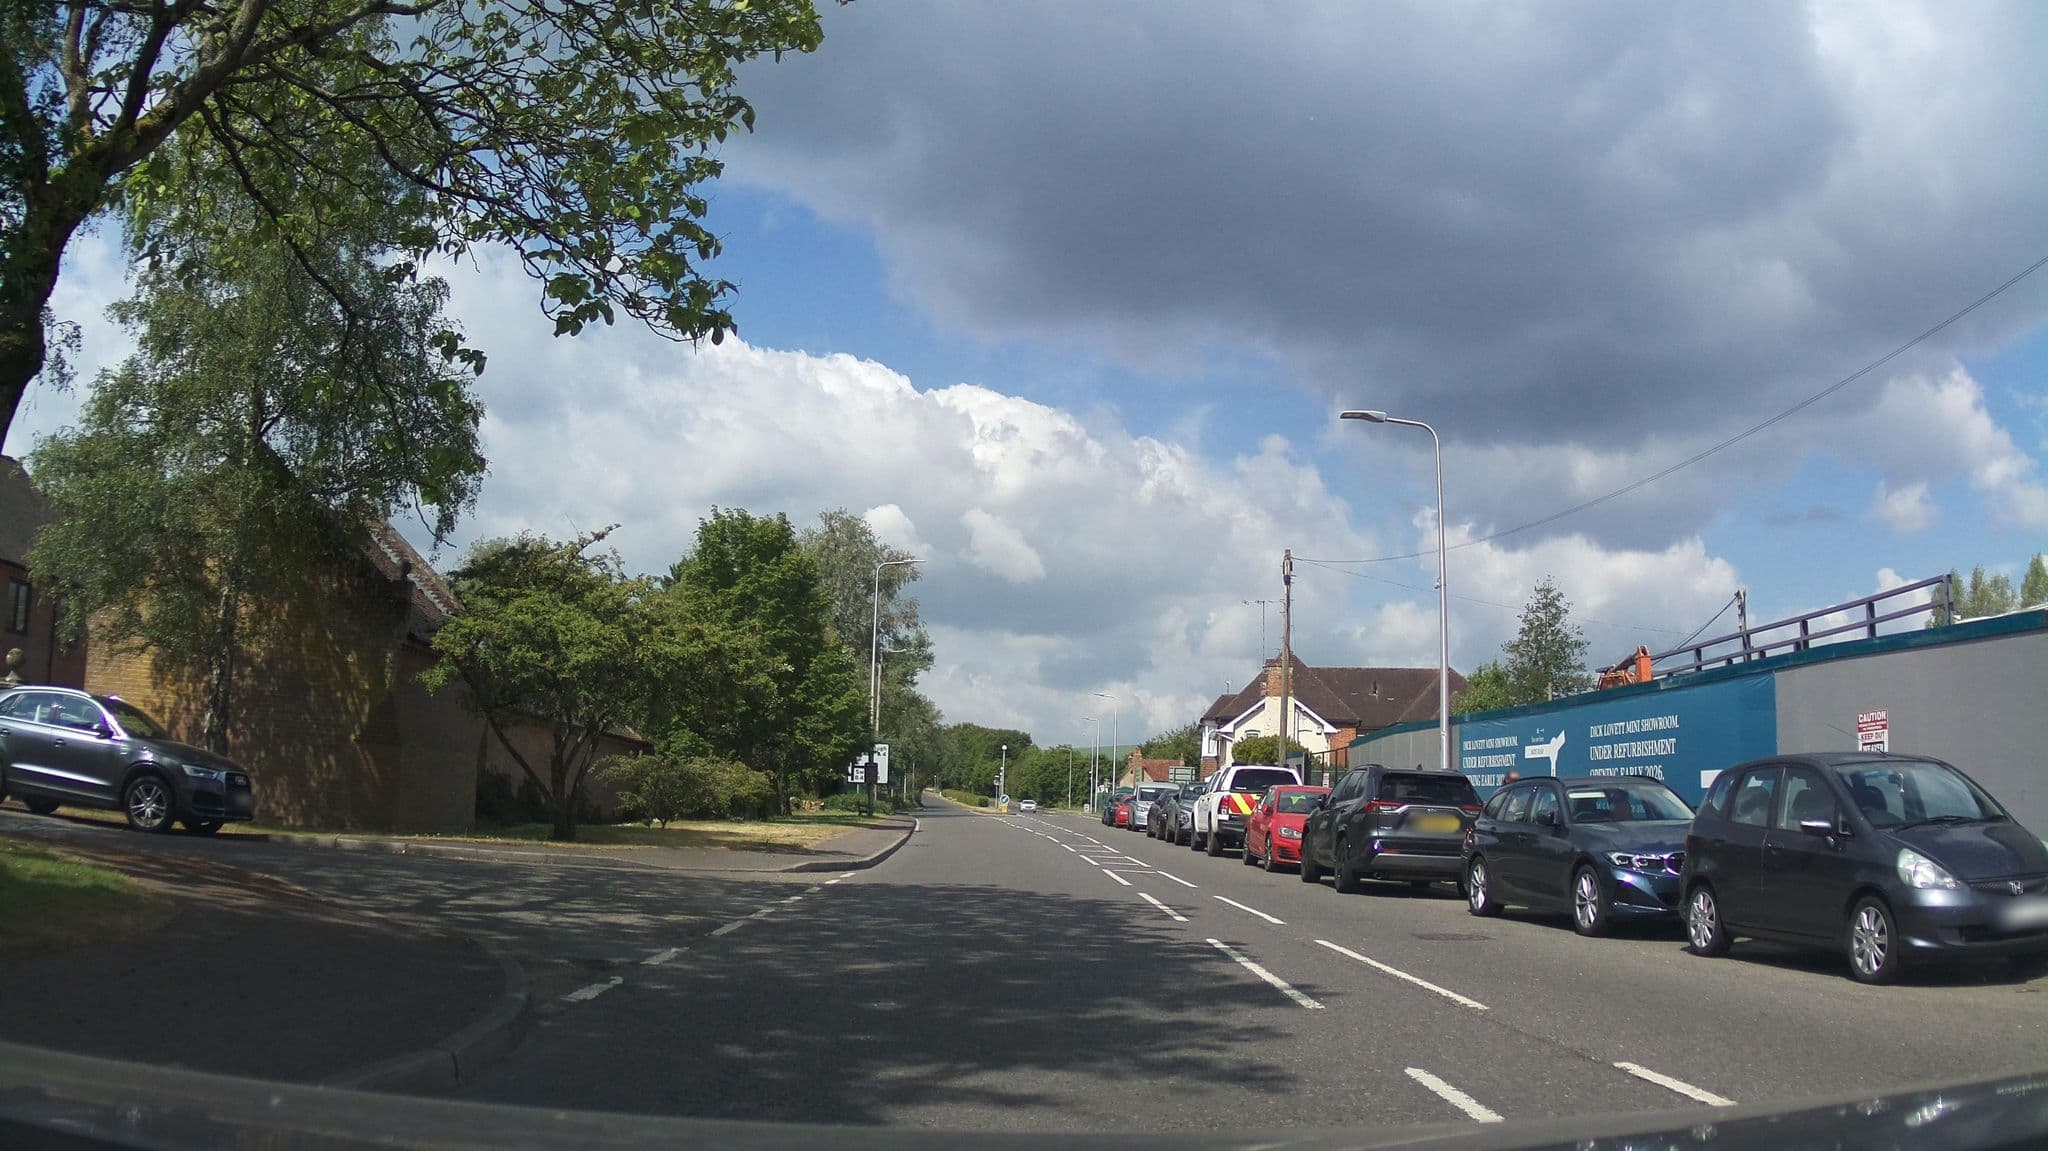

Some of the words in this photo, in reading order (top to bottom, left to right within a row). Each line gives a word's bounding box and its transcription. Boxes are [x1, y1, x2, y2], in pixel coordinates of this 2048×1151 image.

[1859, 711, 1886, 723] CAUTION
[1590, 724, 1603, 738] DICK
[1604, 722, 1625, 736] LOVETT
[1626, 720, 1640, 734] MINI
[1861, 732, 1873, 740] KEEP
[1875, 731, 1885, 739] OUT
[1590, 744, 1613, 760] UNDER
[1614, 738, 1676, 759] REFURBISHMENT
[1620, 765, 1643, 776] EARLY
